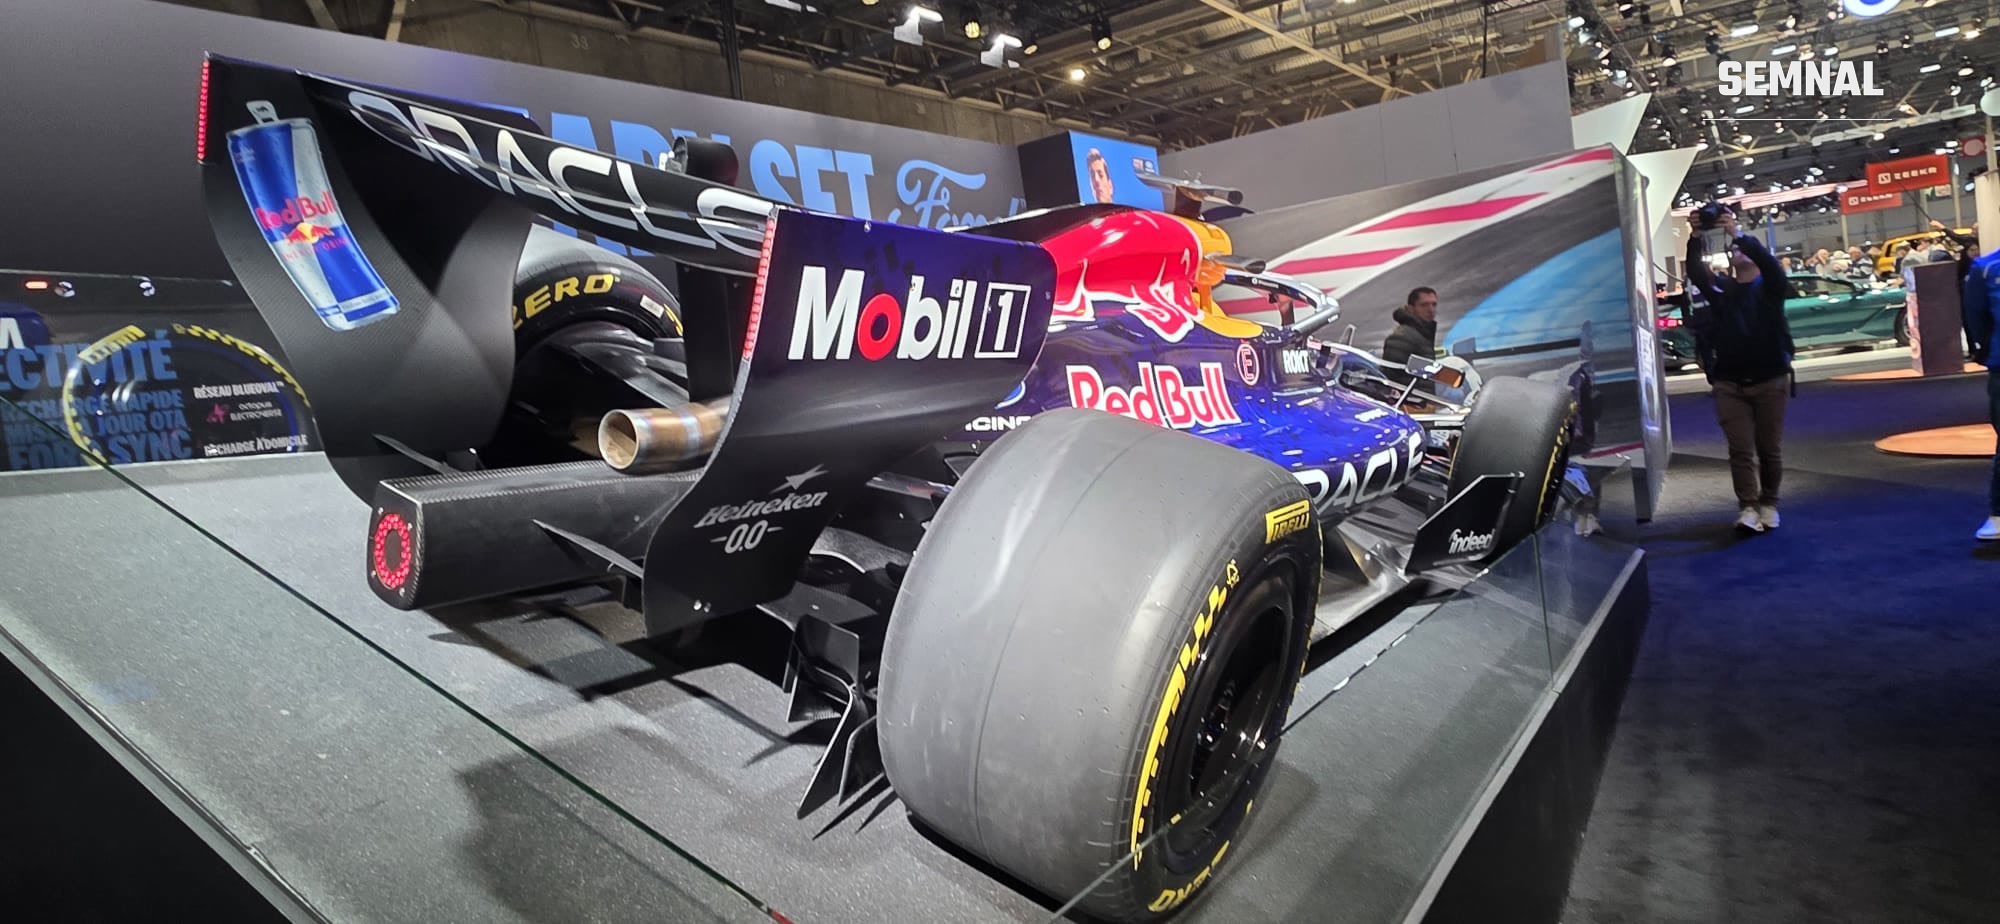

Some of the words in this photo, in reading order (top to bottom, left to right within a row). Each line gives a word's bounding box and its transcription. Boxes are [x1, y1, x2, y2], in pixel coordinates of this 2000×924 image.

[348, 90, 775, 258] ORACLE
[297, 191, 336, 219] Bull
[787, 265, 977, 361] Mobil
[1283, 350, 1309, 373] ROKT
[1066, 361, 1170, 429] Red
[1154, 361, 1242, 429] Bull
[150, 408, 188, 433] OTA
[107, 430, 193, 464] SYNC
[1292, 431, 1424, 515] RACLE
[693, 491, 828, 529] Heineken
[1265, 499, 1309, 544] PIRELLI
[1450, 528, 1496, 554] indeed
